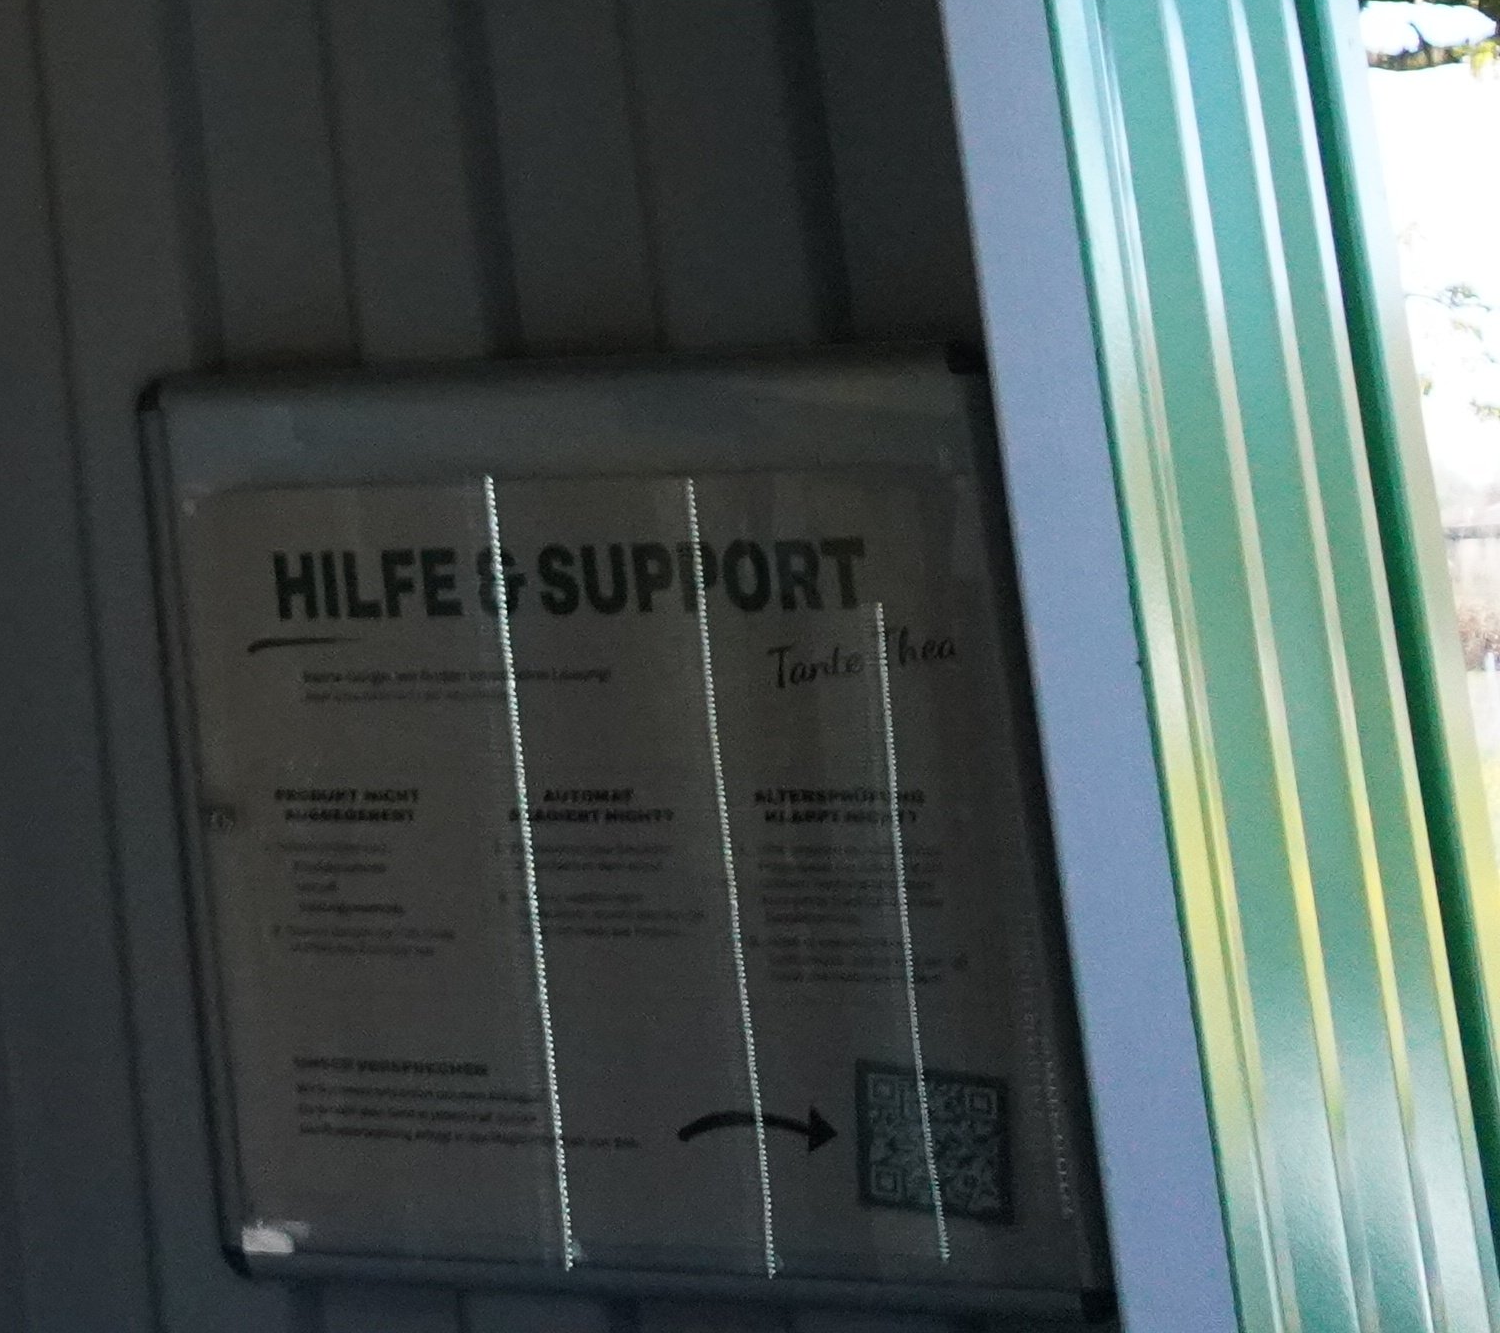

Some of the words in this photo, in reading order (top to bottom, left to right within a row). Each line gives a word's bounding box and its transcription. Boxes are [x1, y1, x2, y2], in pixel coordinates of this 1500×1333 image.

[271, 545, 463, 621] HILFE
[475, 548, 528, 614] &
[536, 535, 865, 617] SUPPORT
[766, 642, 863, 691] Tante
[273, 787, 359, 803] PRODUKT
[362, 788, 420, 804] NICHT
[542, 787, 635, 804] AUTOMAT
[508, 807, 599, 823] RAGIERT
[604, 807, 675, 824] NICHT?
